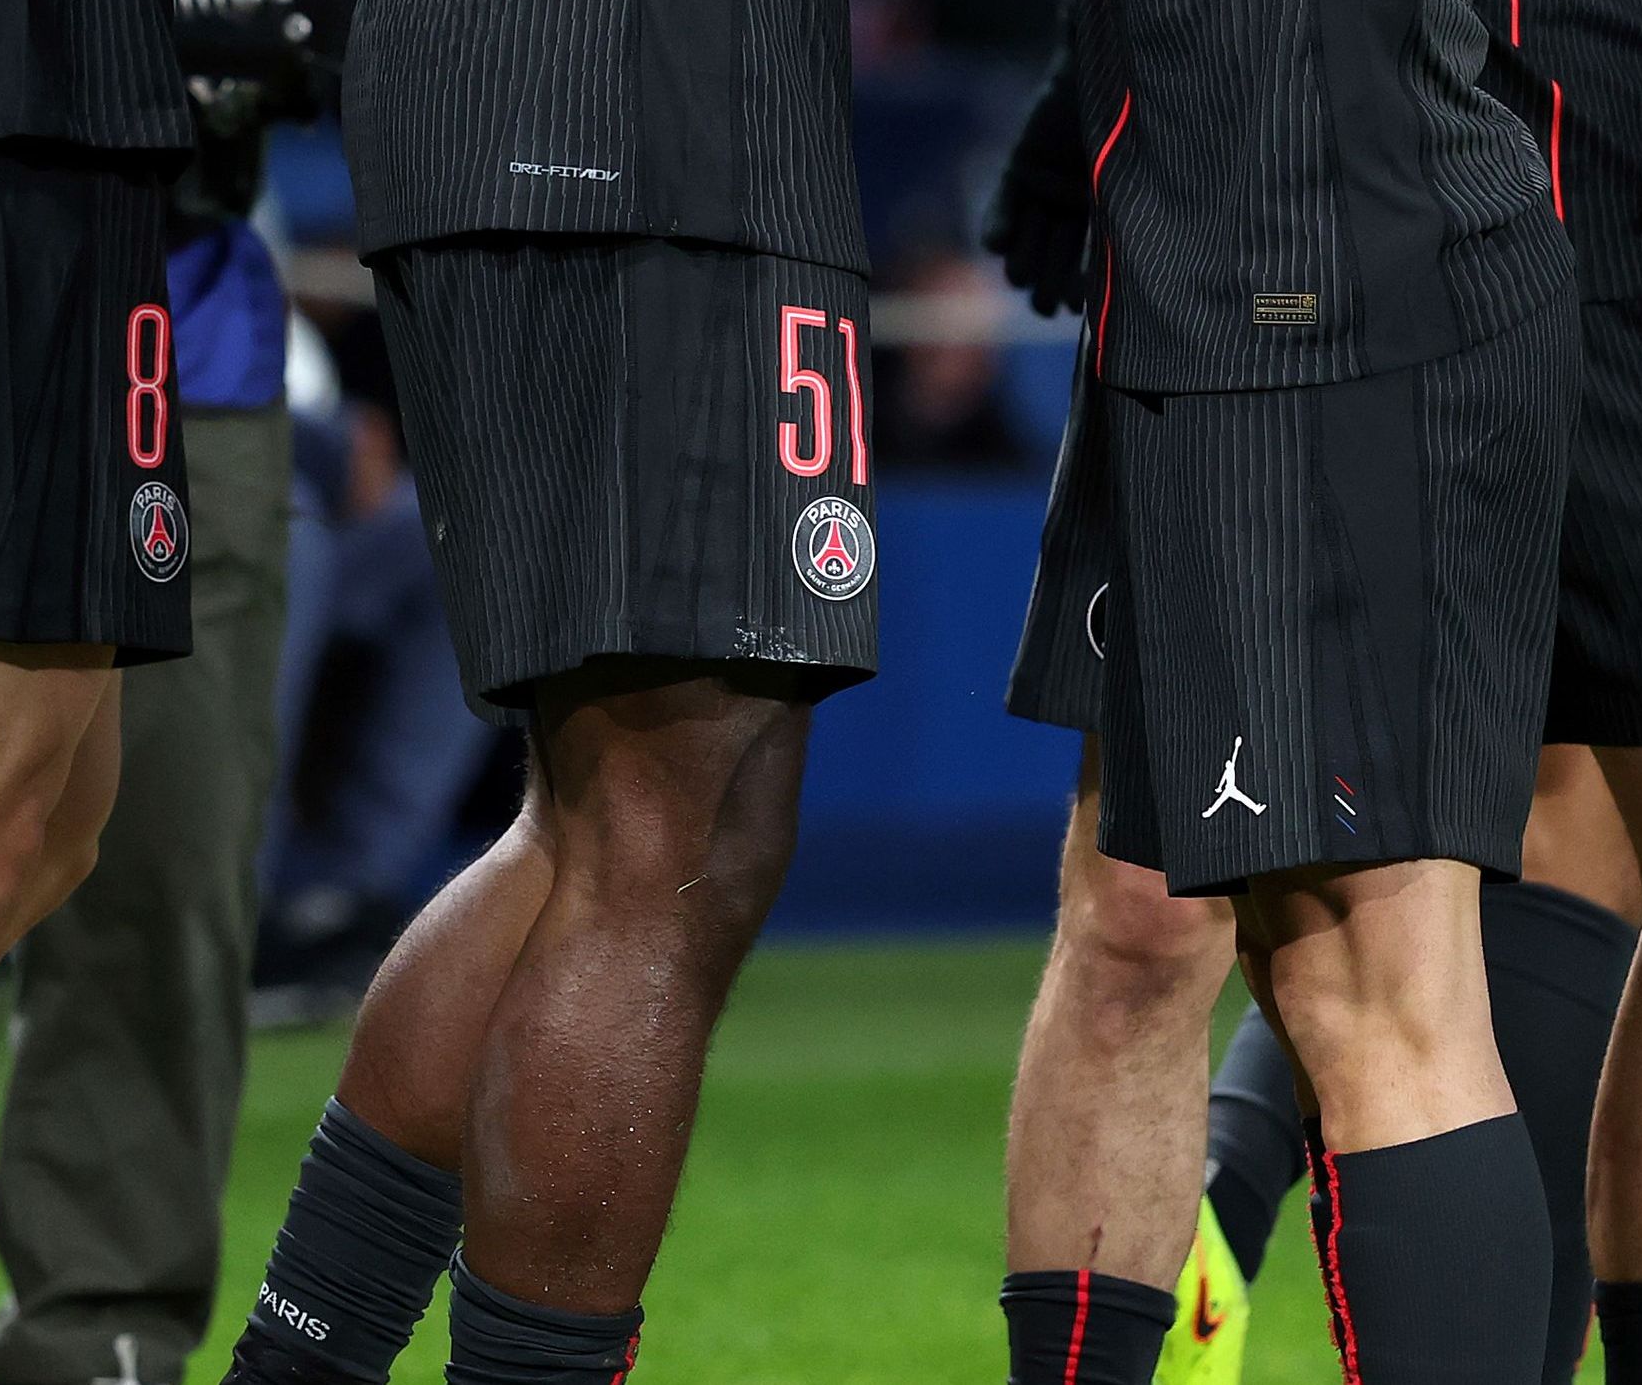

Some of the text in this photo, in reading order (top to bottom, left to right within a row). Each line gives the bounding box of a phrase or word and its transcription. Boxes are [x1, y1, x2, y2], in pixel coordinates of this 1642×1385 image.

[126, 303, 171, 469] 8
[778, 304, 868, 487] 51
[136, 486, 177, 511] PARIS
[806, 501, 861, 529] PARIS
[258, 1281, 331, 1341] PARIS
